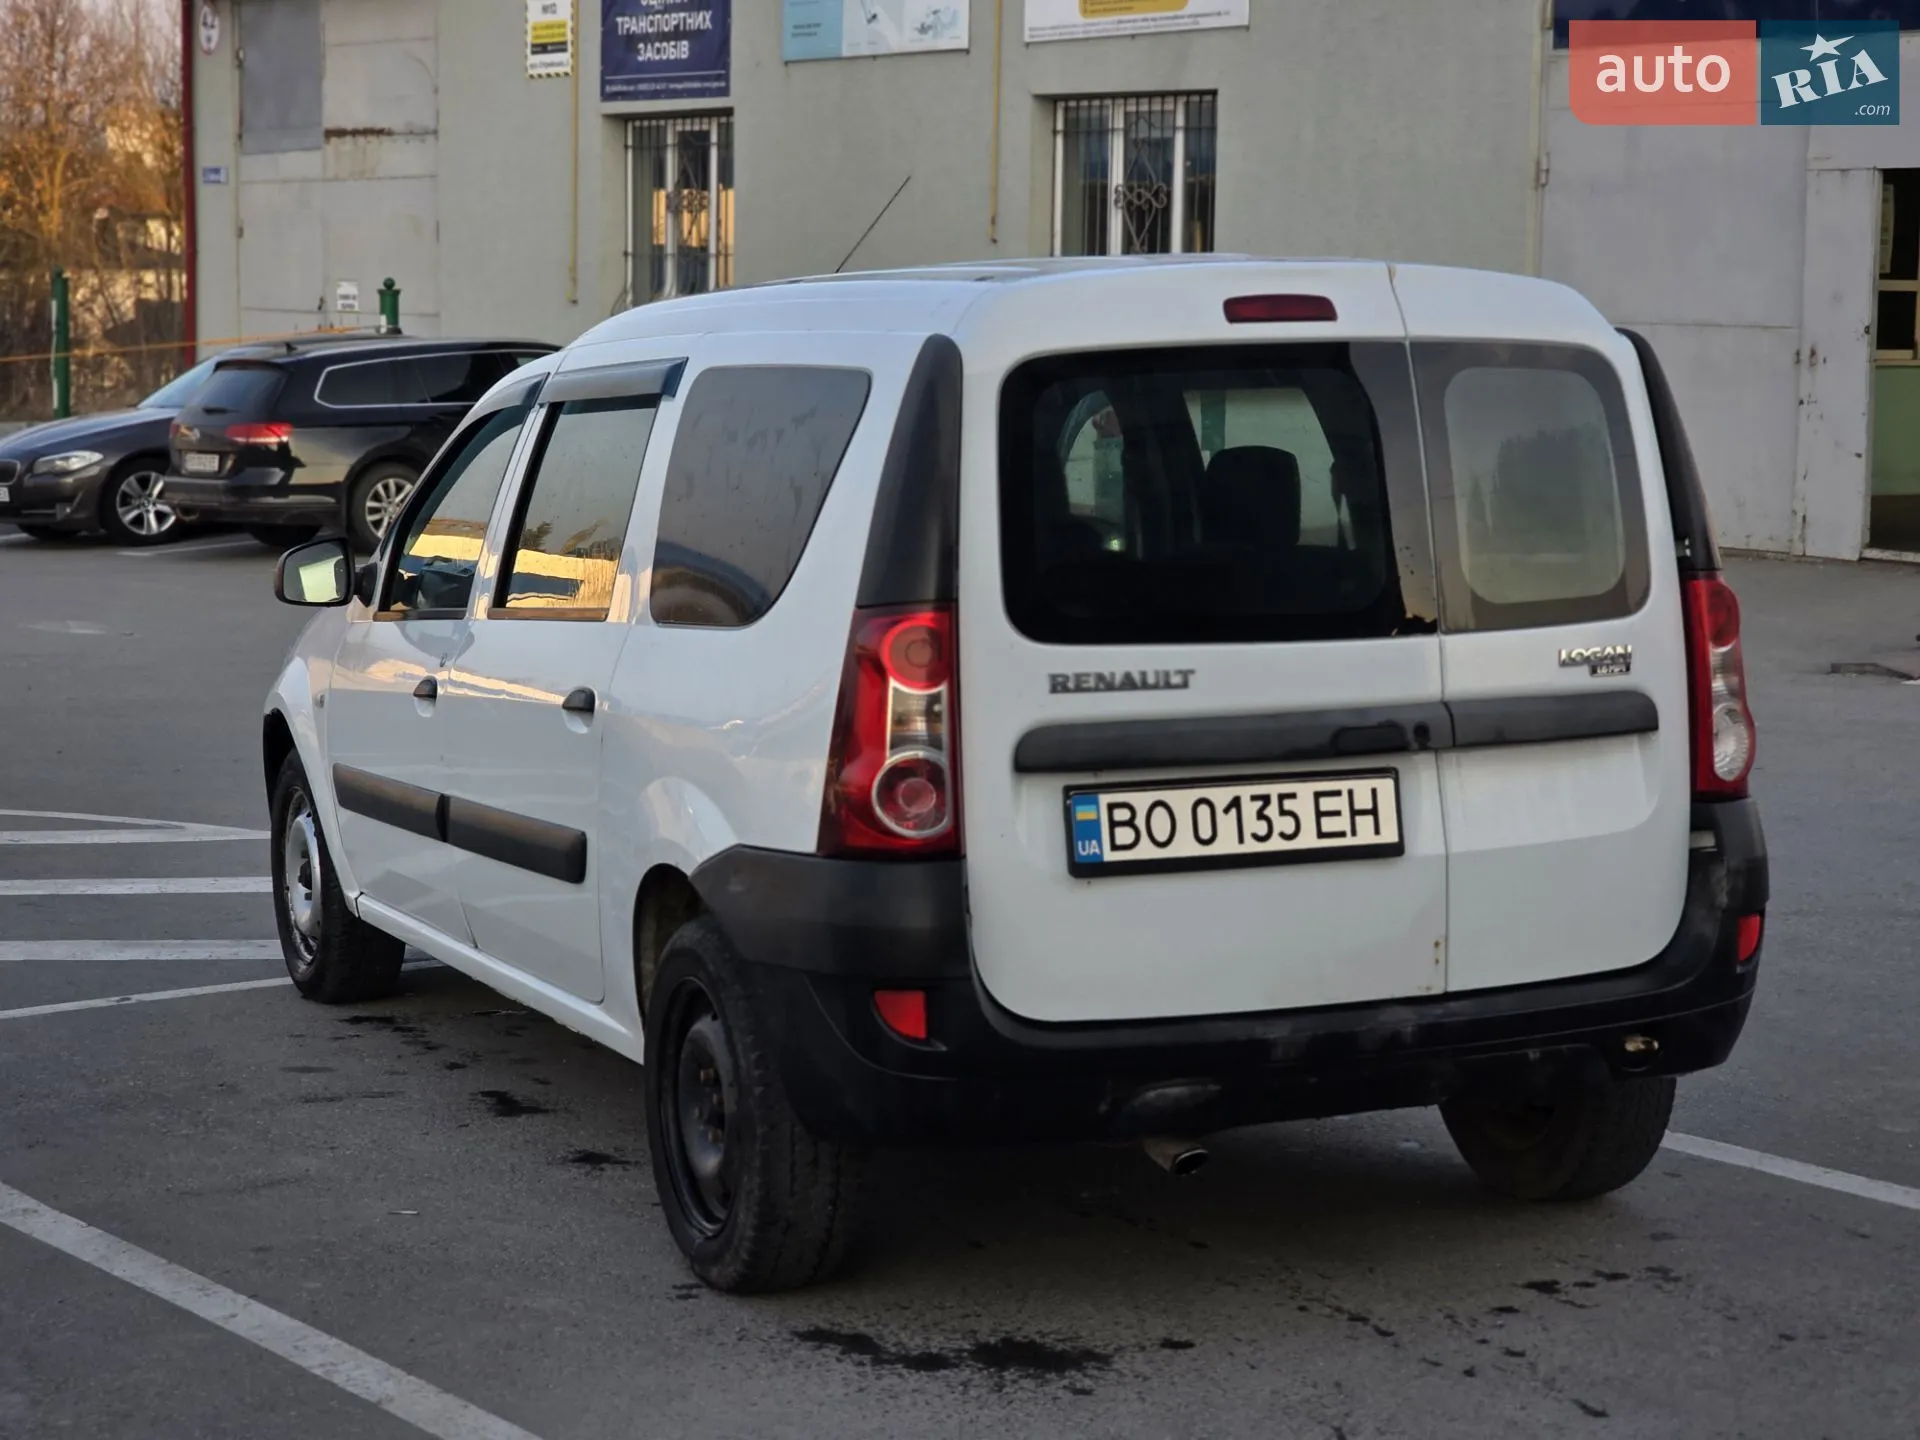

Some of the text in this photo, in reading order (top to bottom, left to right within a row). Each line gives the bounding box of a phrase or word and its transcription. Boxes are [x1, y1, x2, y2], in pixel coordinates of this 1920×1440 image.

[616, 10, 713, 36] ТРАНСПОРТНИХ
[637, 40, 690, 61] ЗАСОБІВ
[1558, 644, 1632, 667] LOGAN
[1048, 669, 1196, 694] RENAULT
[1106, 787, 1381, 852] BO 0135 EH
[1077, 840, 1101, 856] UA
